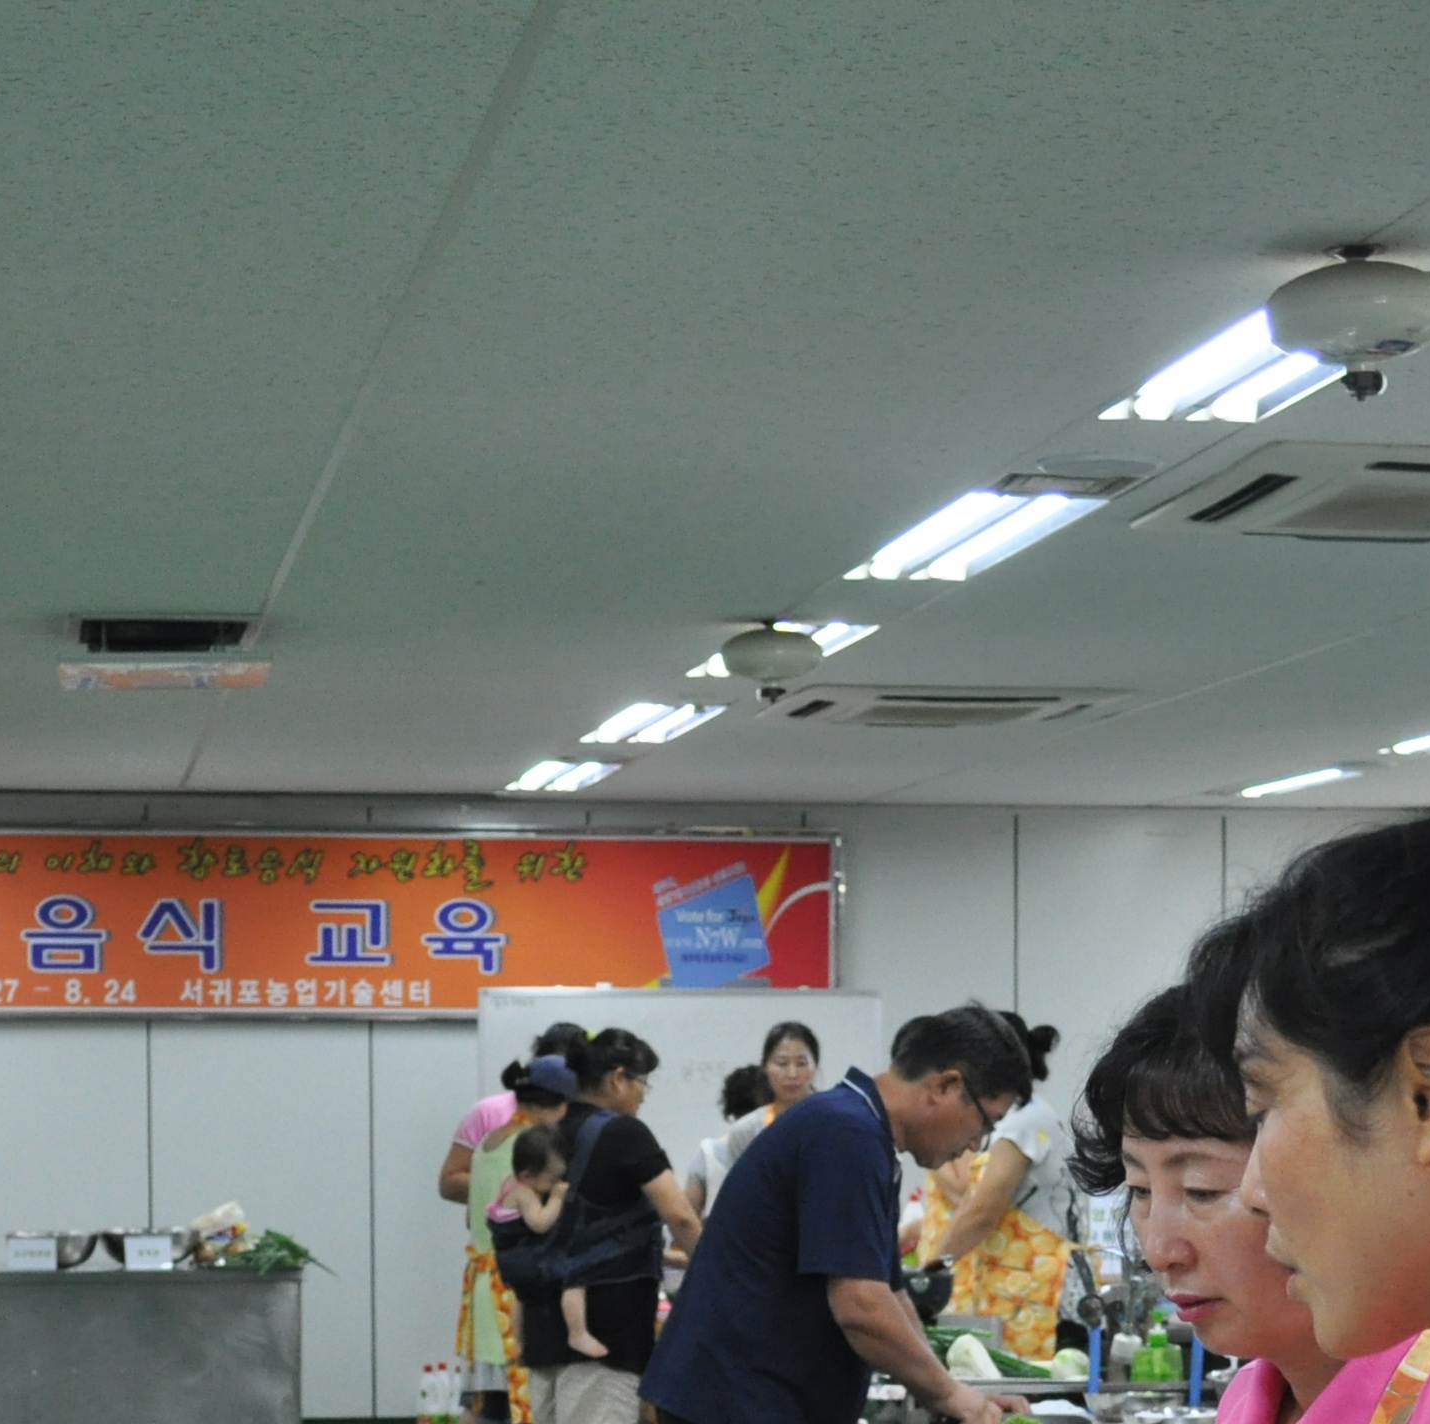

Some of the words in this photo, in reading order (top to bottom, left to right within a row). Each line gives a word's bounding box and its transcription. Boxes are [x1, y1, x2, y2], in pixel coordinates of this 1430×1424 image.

[44, 841, 156, 876] 이해와
[348, 838, 494, 892] 자원화를
[514, 841, 586, 882] 위한
[305, 898, 509, 976] 교육
[180, 977, 433, 1006] 서귀포농업기술센터
